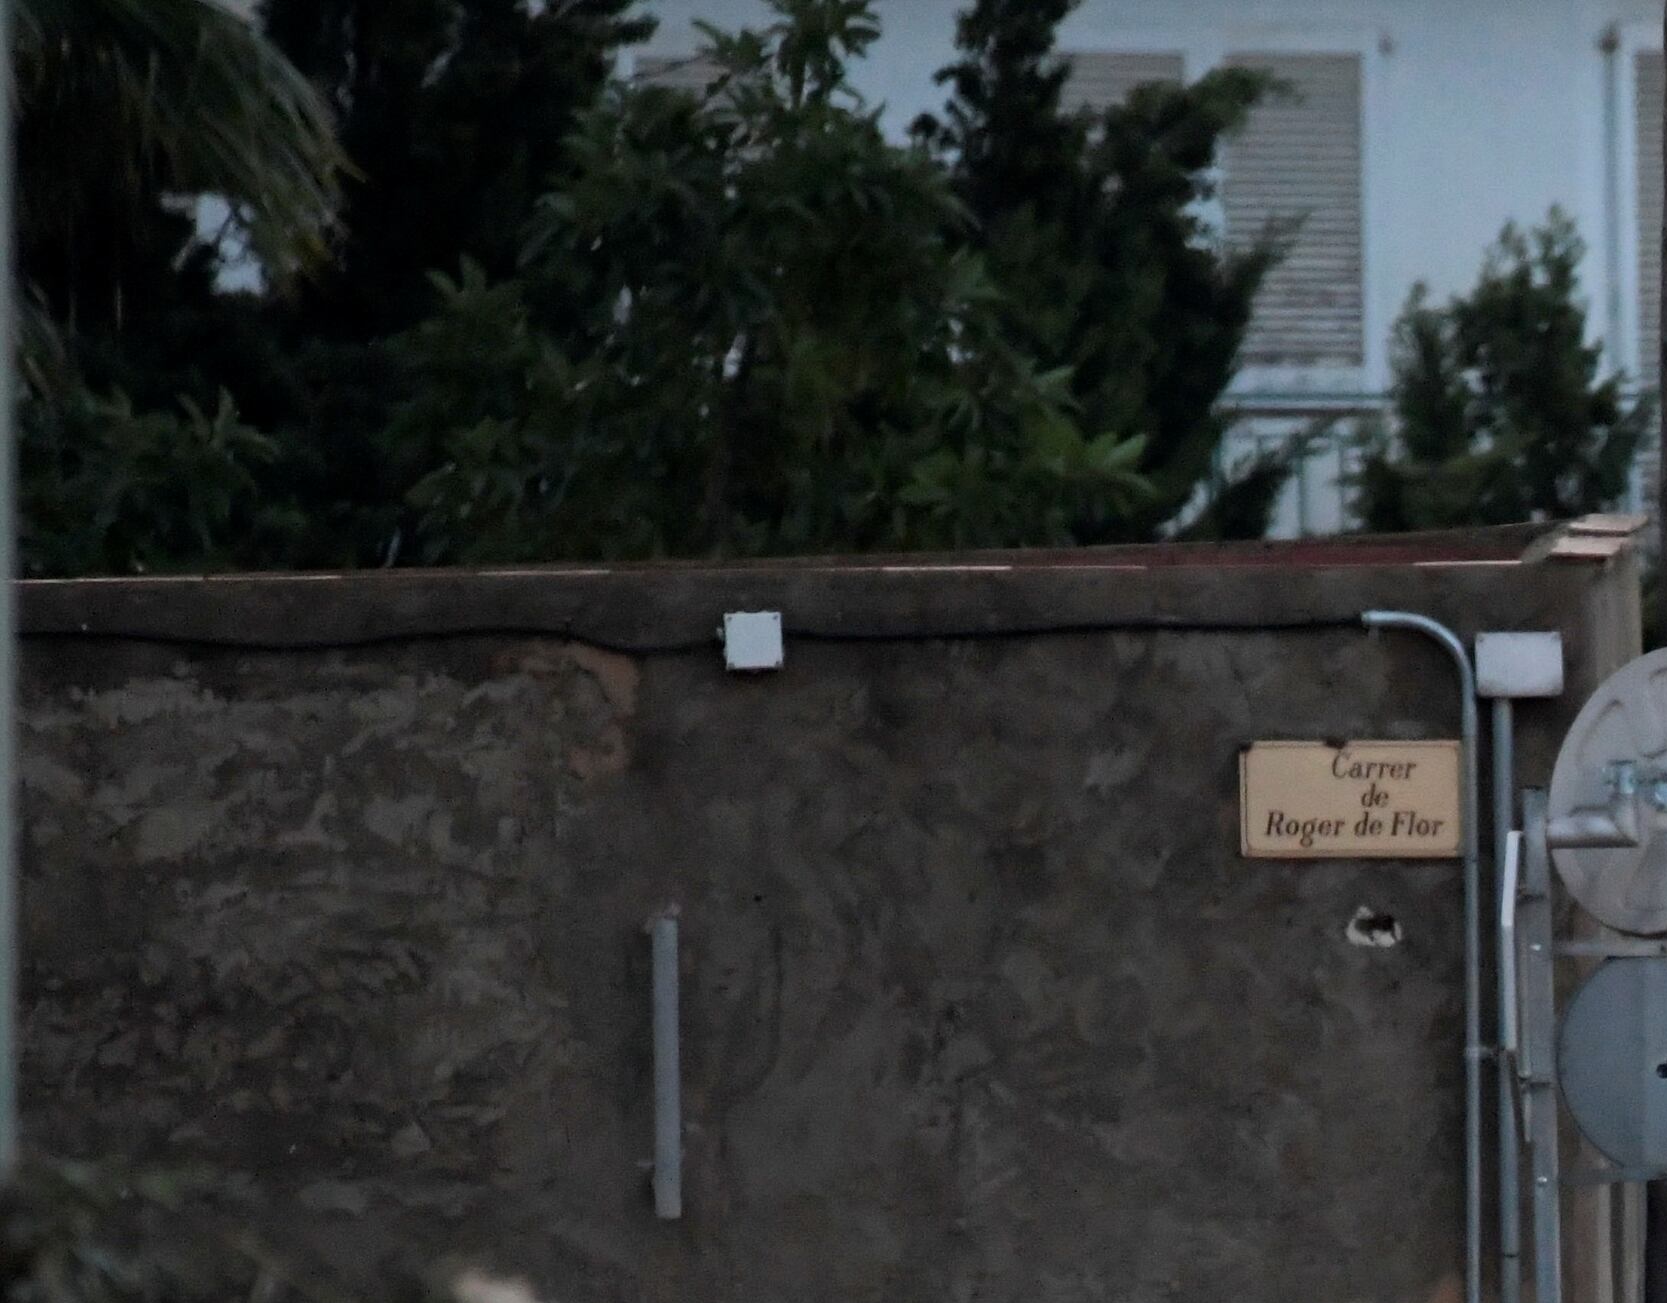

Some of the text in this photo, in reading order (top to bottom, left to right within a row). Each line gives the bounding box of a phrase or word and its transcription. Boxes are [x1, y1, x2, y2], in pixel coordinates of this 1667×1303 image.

[1331, 751, 1417, 780] Carrer
[1360, 783, 1390, 809] de
[1265, 809, 1446, 848] Roger de Flor
